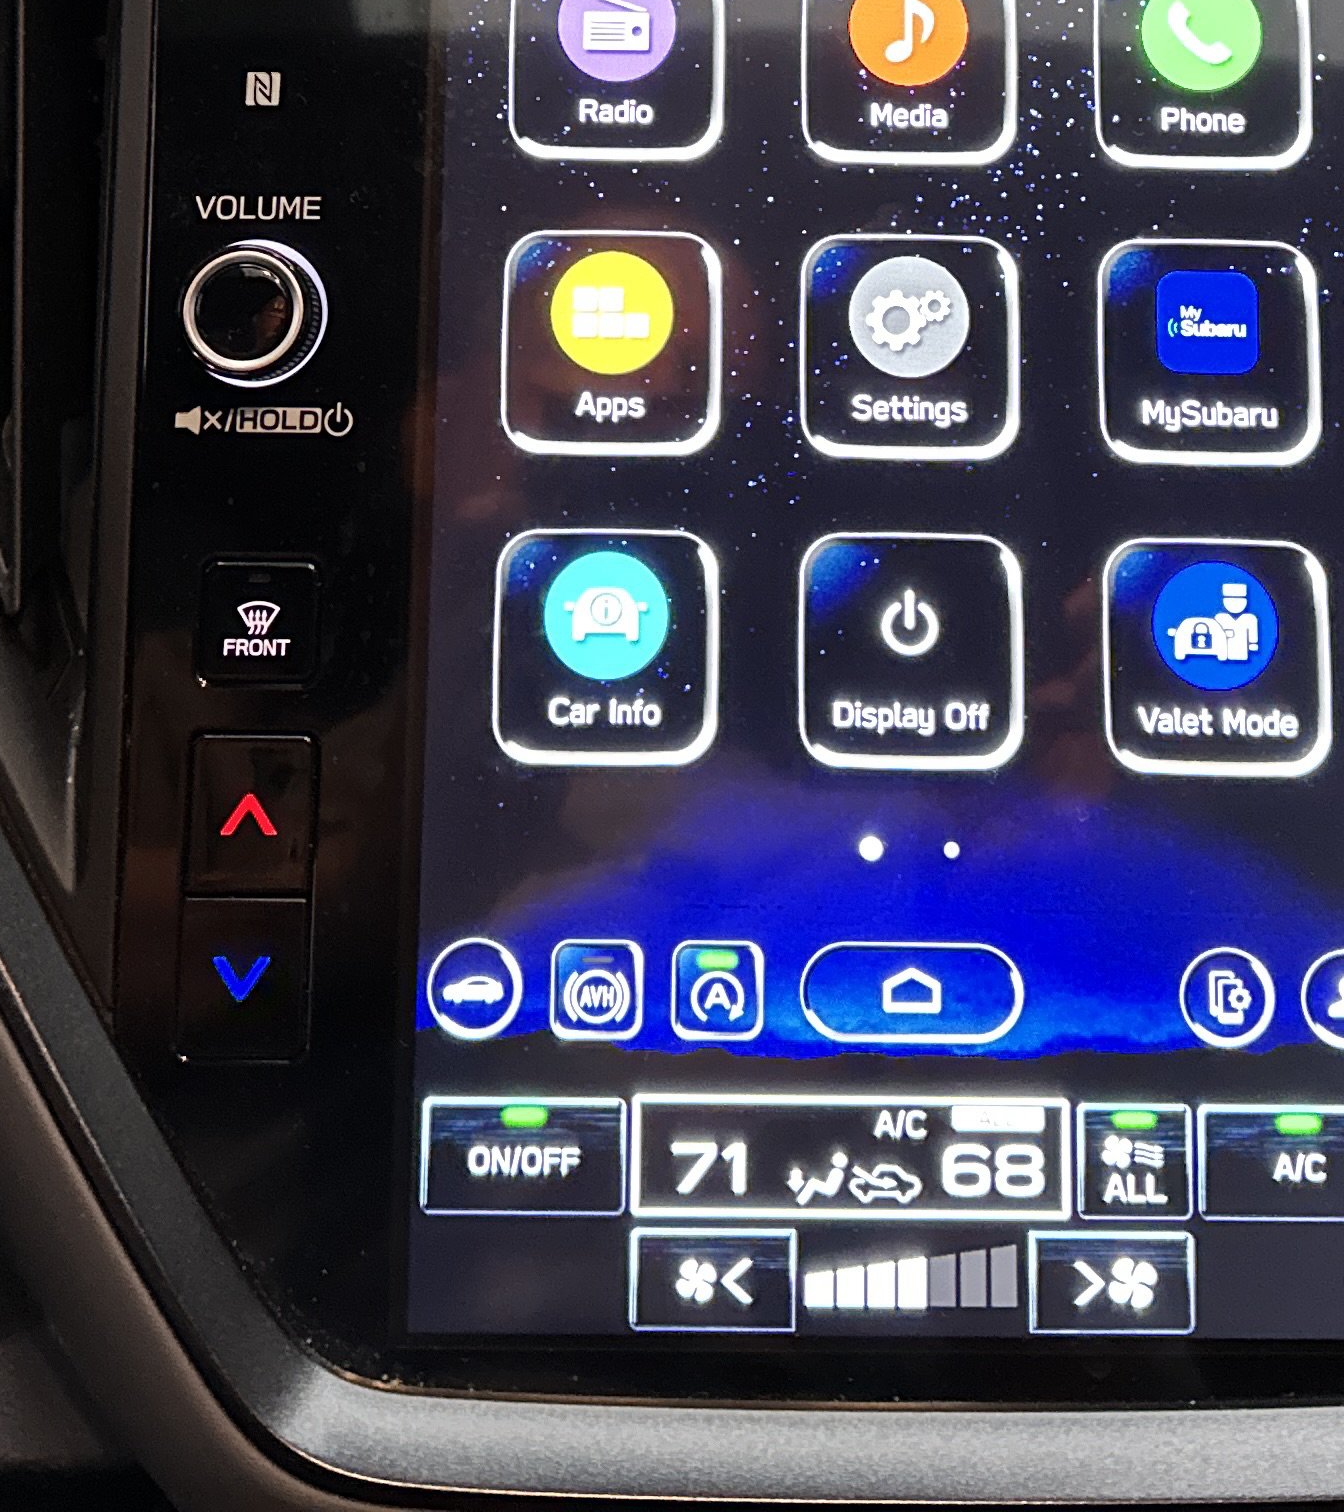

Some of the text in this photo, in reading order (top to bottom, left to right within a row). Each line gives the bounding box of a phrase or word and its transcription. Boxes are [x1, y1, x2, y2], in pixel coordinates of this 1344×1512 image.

[578, 98, 655, 126] Radio
[869, 102, 949, 131] Media
[1160, 106, 1246, 134] Phone
[195, 195, 322, 220] VOLUME
[1179, 305, 1203, 322] My
[1179, 319, 1248, 338] Subaru
[239, 409, 320, 431] HOLD
[574, 390, 646, 423] Apps
[851, 393, 969, 429] Settings
[1139, 398, 1279, 433] MySubaru
[222, 638, 291, 657] FRONT
[547, 695, 662, 727] Car Info
[831, 699, 990, 737] Display Off
[1136, 705, 1300, 739] Valet Mode
[579, 985, 615, 1008] AVH
[873, 1109, 929, 1140] A/C
[467, 1144, 581, 1177] ON/OFF
[670, 1141, 748, 1196] 71
[940, 1141, 1046, 1198] 68
[1272, 1151, 1327, 1183] A/C
[1102, 1171, 1169, 1204] ALL
